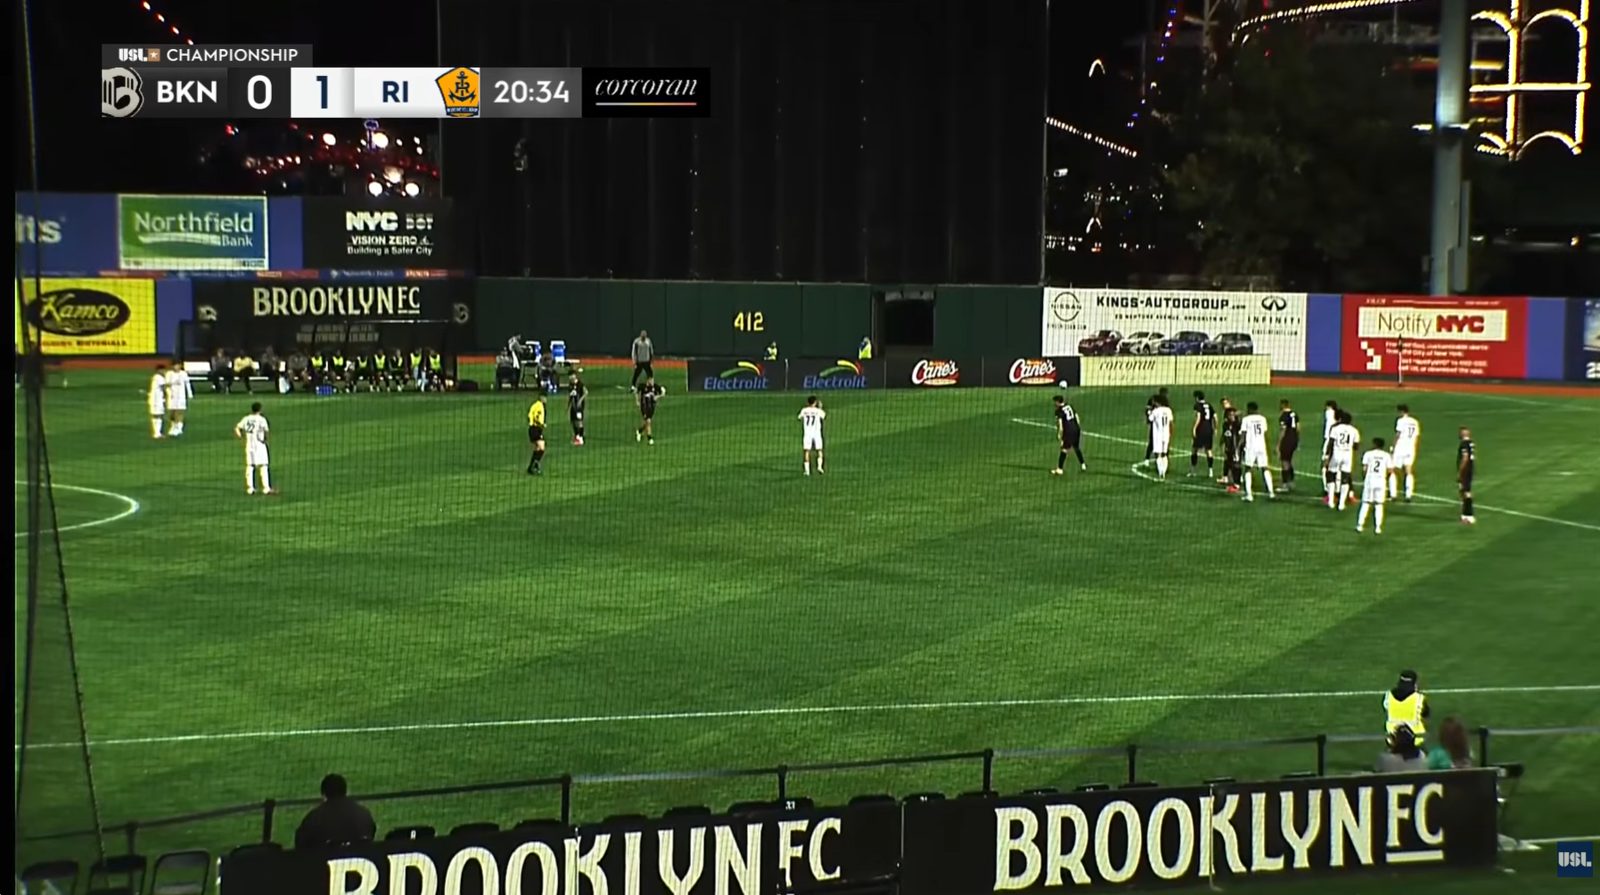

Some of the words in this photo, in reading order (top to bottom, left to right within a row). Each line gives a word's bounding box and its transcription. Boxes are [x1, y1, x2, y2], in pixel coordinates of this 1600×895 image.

[134, 211, 254, 233] Northfield
[346, 211, 398, 231] NYC
[221, 234, 253, 247] Bank
[351, 236, 386, 246] VISION
[388, 236, 418, 246] ZERO
[347, 246, 382, 256] Building
[391, 247, 413, 255] Safer
[416, 246, 432, 256] City
[40, 293, 119, 322] Kamco
[253, 286, 393, 316] BROOKLYN
[397, 286, 420, 310] FC
[734, 311, 764, 332] 412
[1378, 312, 1432, 336] Notify
[1436, 315, 1484, 333] NYC
[912, 359, 958, 385] Cane's
[1009, 358, 1056, 384] Cane's
[1100, 360, 1156, 371] corcoran
[1195, 360, 1252, 371] corcoran
[703, 376, 769, 390] Electrolit
[803, 375, 867, 389] Electrolit
[1374, 461, 1380, 473] 2
[994, 786, 1374, 891] BROOKLYN
[1386, 782, 1443, 848] FC
[778, 817, 841, 887] FC
